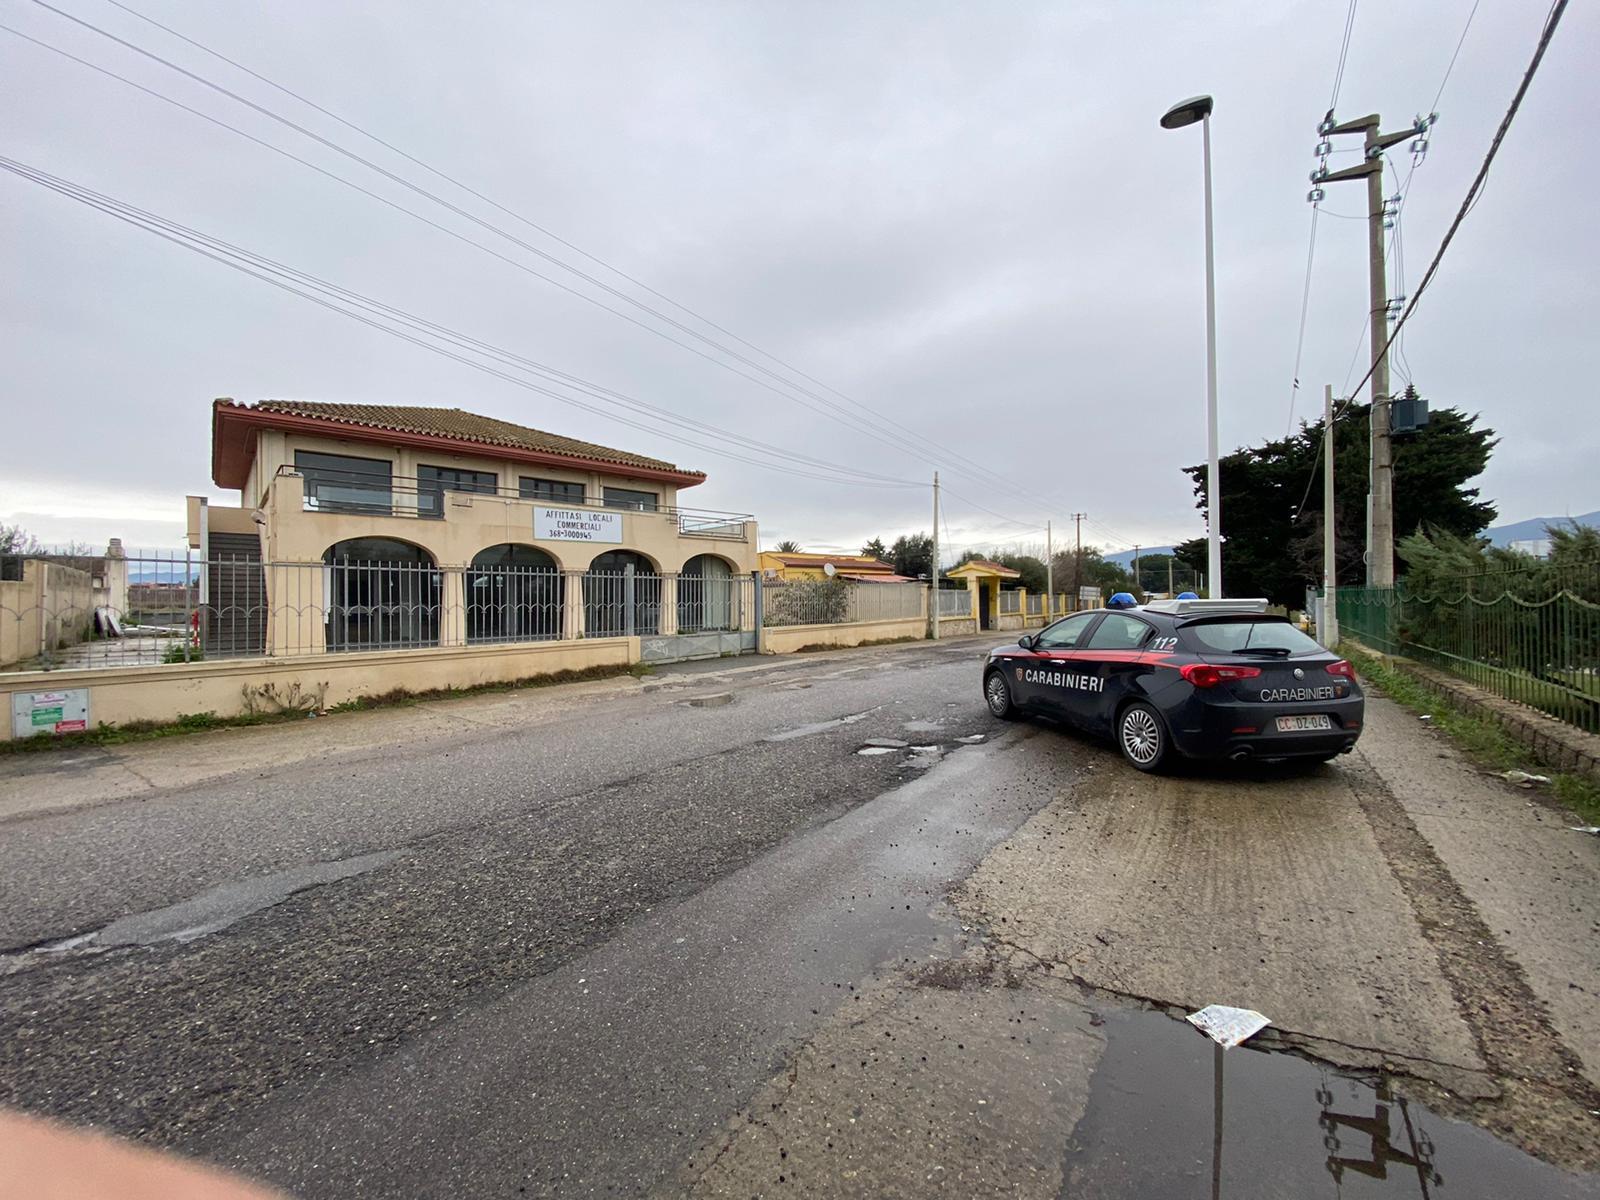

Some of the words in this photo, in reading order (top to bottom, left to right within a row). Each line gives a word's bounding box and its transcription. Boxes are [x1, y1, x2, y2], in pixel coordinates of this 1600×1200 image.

[546, 510, 581, 520] AFFITTASI
[589, 514, 613, 522] LOCALI
[557, 520, 601, 530] COMMERCIALI
[1153, 637, 1178, 649] 112
[1025, 669, 1104, 692] CARABINIERI
[1260, 686, 1333, 702] CARABINIERI
